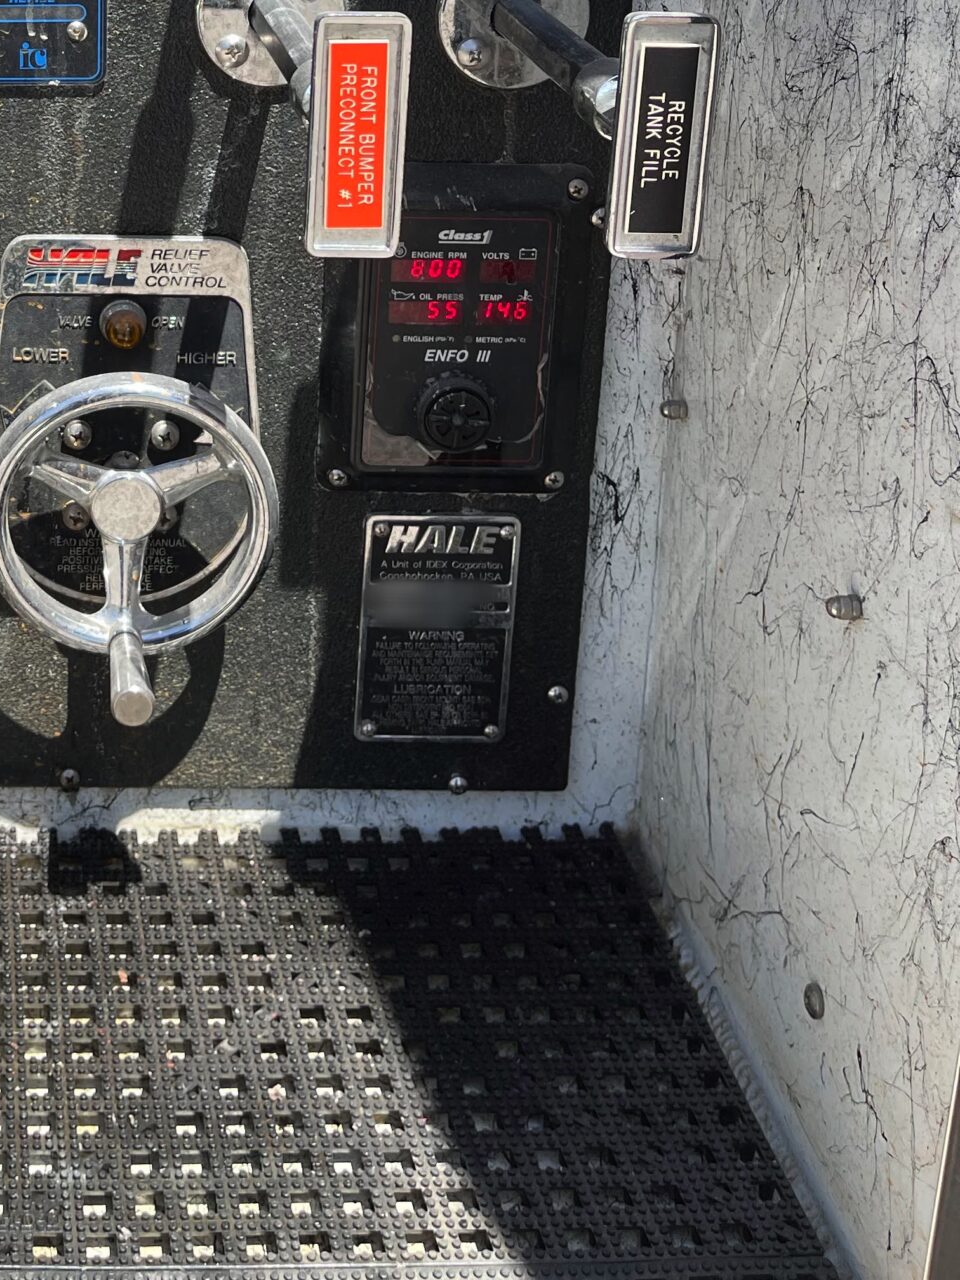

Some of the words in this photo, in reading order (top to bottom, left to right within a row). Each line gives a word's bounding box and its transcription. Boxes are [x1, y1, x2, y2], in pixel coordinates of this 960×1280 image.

[359, 66, 378, 124] FRONT
[338, 64, 358, 177] PRECONNECT
[646, 92, 666, 140] TANK
[662, 100, 686, 180] RECYCLE
[357, 134, 376, 206] BUMPER
[640, 148, 660, 188] FILL
[338, 189, 354, 208] #1
[438, 230, 493, 244] Class1
[150, 248, 210, 260] RELIEF
[412, 251, 444, 259] ENGINE
[448, 251, 468, 259] RPM
[482, 252, 510, 260] VOLTS
[150, 263, 202, 275] VALVE
[145, 276, 227, 288] CONTROL
[480, 294, 503, 302] TEMP
[428, 301, 458, 320] 55
[58, 316, 93, 328] VALVE
[152, 317, 186, 330] OPEN
[403, 335, 434, 343] ENGLISH
[476, 336, 503, 344] METRIC
[12, 346, 70, 364] LOWER
[177, 351, 237, 366] HIGHER
[424, 349, 469, 362] ENFO
[476, 350, 491, 362] III
[385, 525, 502, 554] HALE
[413, 560, 422, 568] of
[408, 630, 465, 640] WARNING
[394, 684, 472, 694] LUBRICATION
